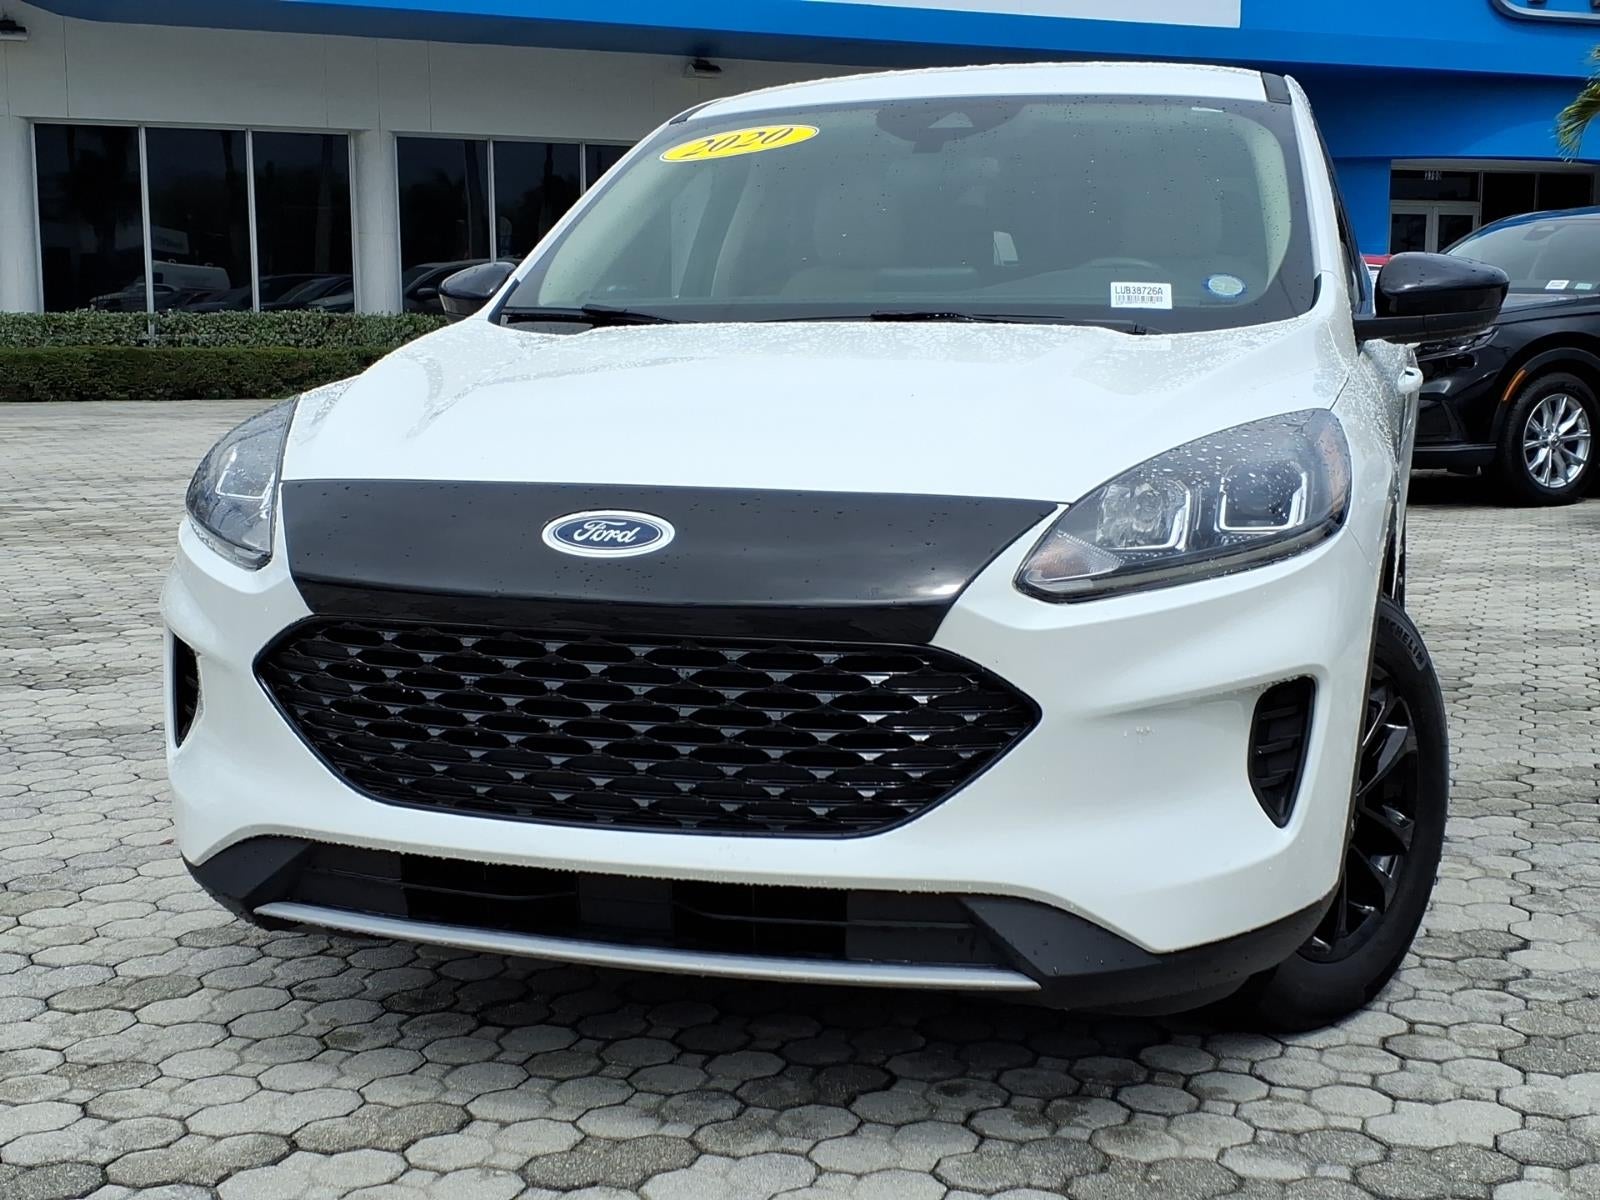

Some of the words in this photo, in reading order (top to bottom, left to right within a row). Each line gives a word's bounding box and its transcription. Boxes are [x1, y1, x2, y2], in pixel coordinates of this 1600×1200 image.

[680, 127, 794, 158] 2020
[1114, 285, 1164, 296] LUB38726A
[573, 520, 641, 543] Ford
